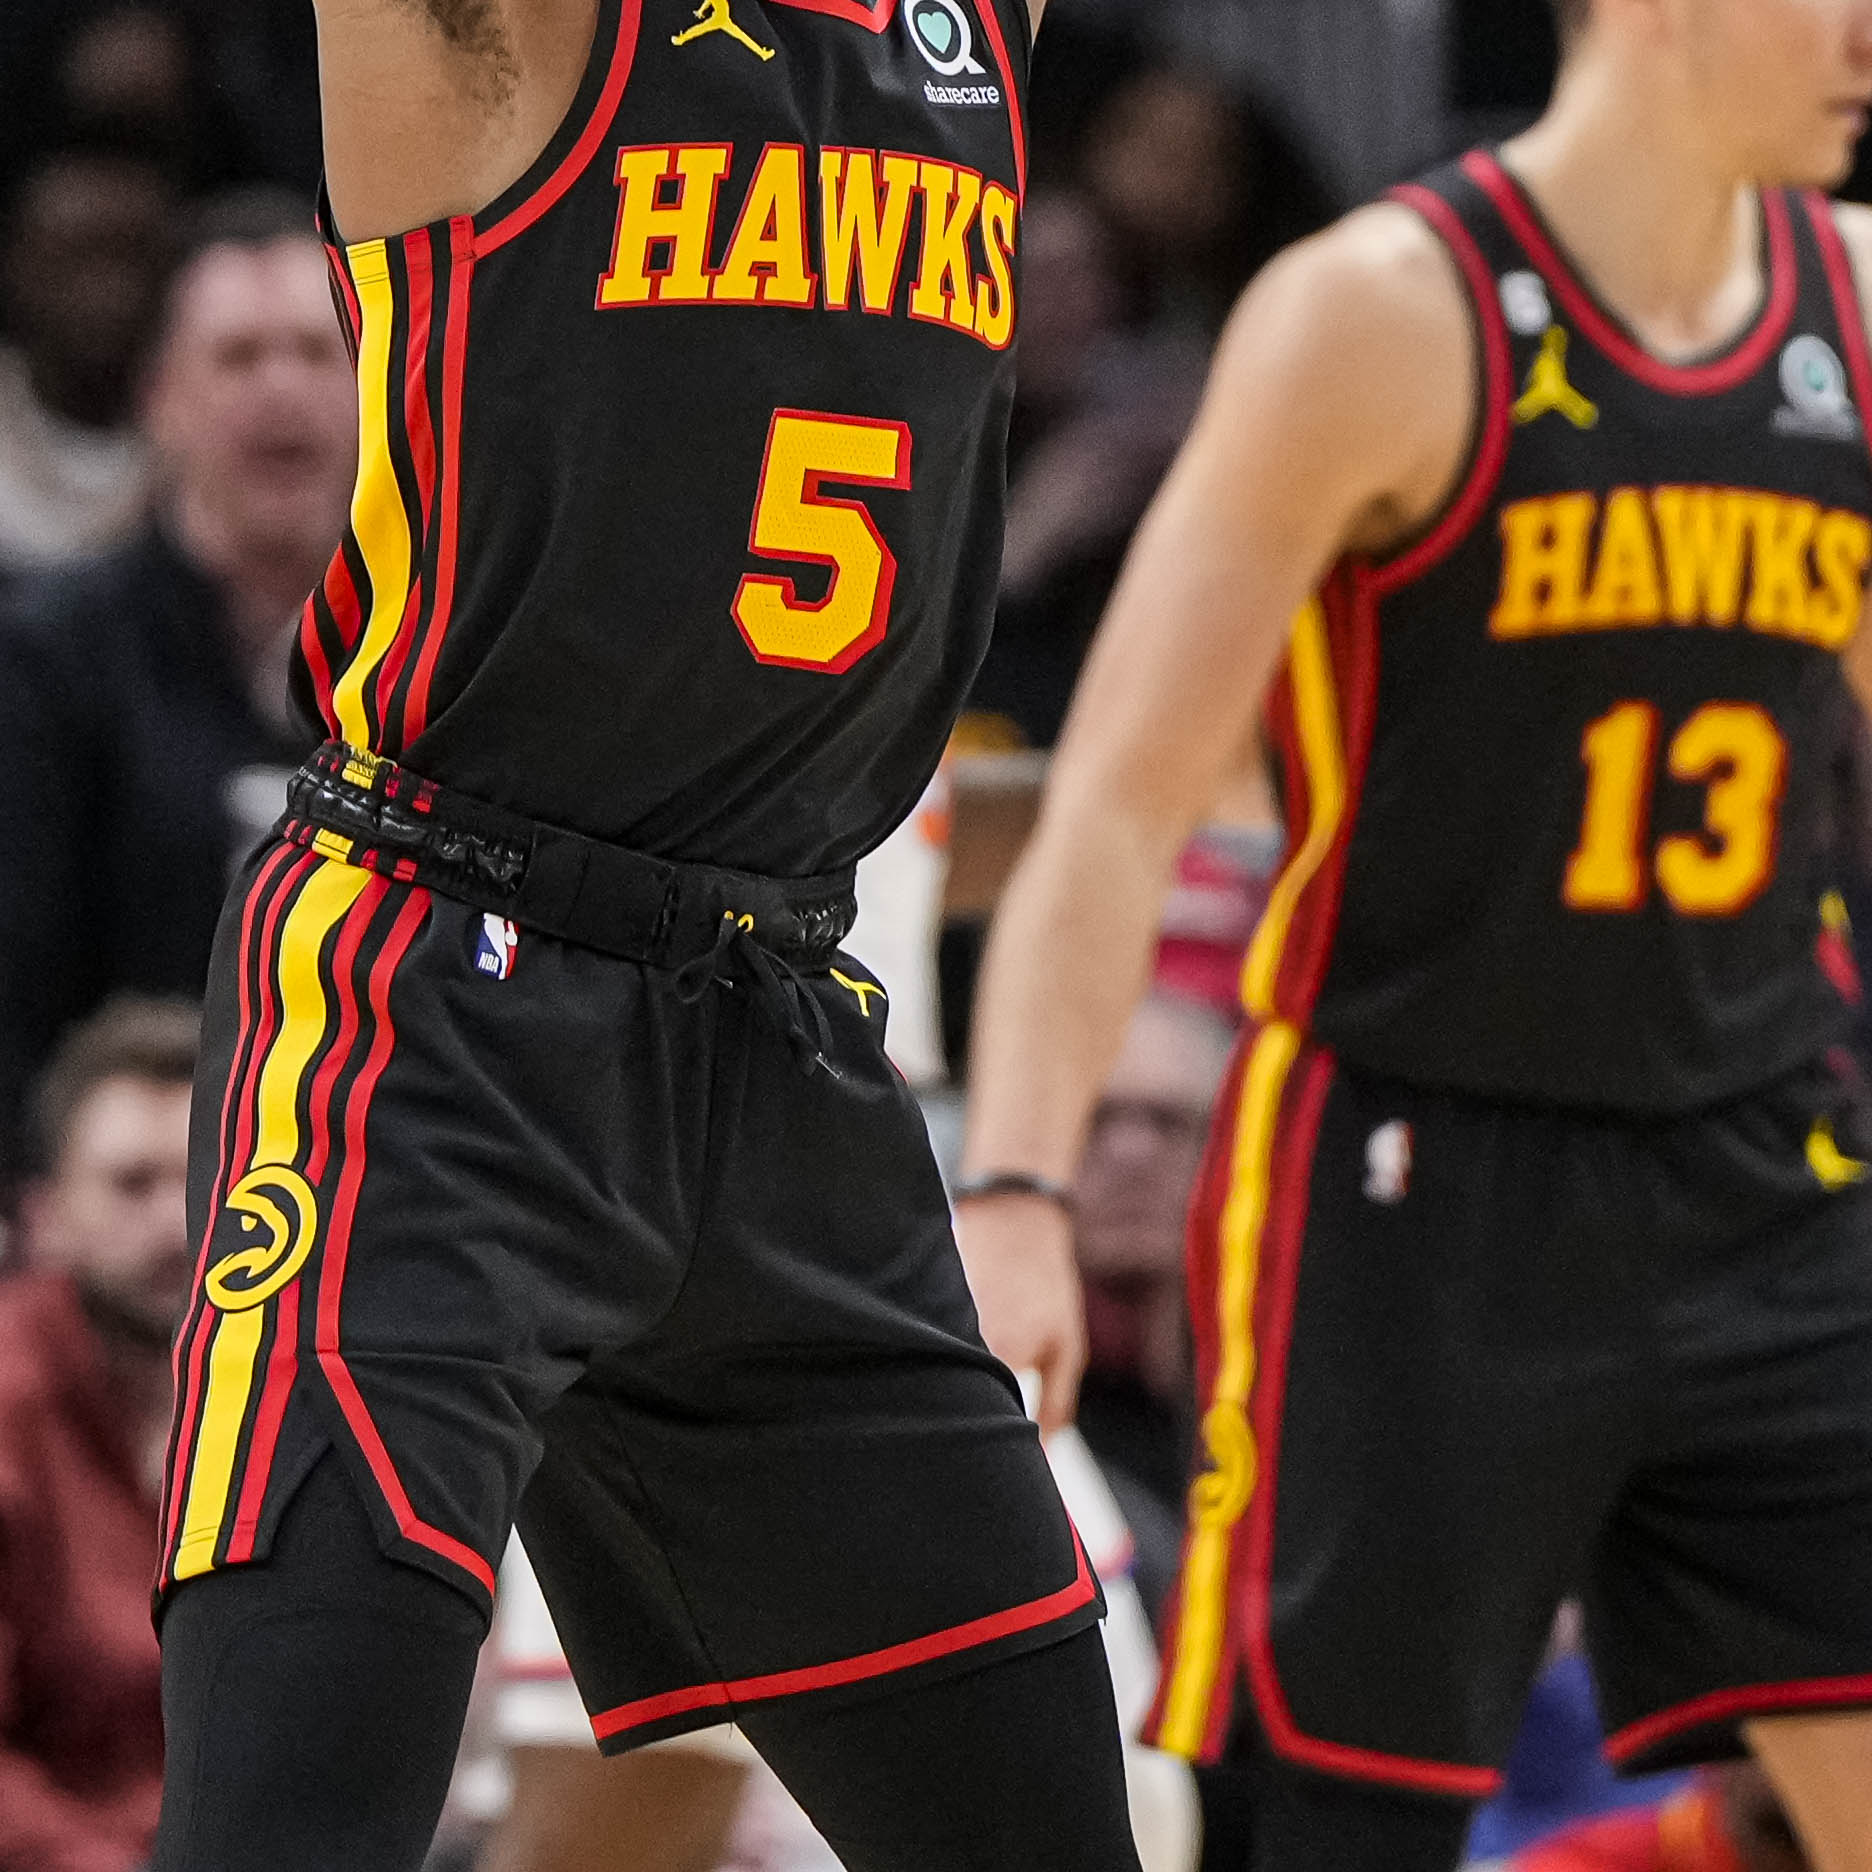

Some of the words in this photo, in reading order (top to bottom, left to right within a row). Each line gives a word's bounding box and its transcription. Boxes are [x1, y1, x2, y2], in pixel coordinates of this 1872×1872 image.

[923, 79, 1001, 106] sharecare
[594, 142, 1019, 351] HAWKS
[729, 407, 913, 675] 5
[1559, 697, 1791, 918] 13
[478, 952, 500, 973] NBA
